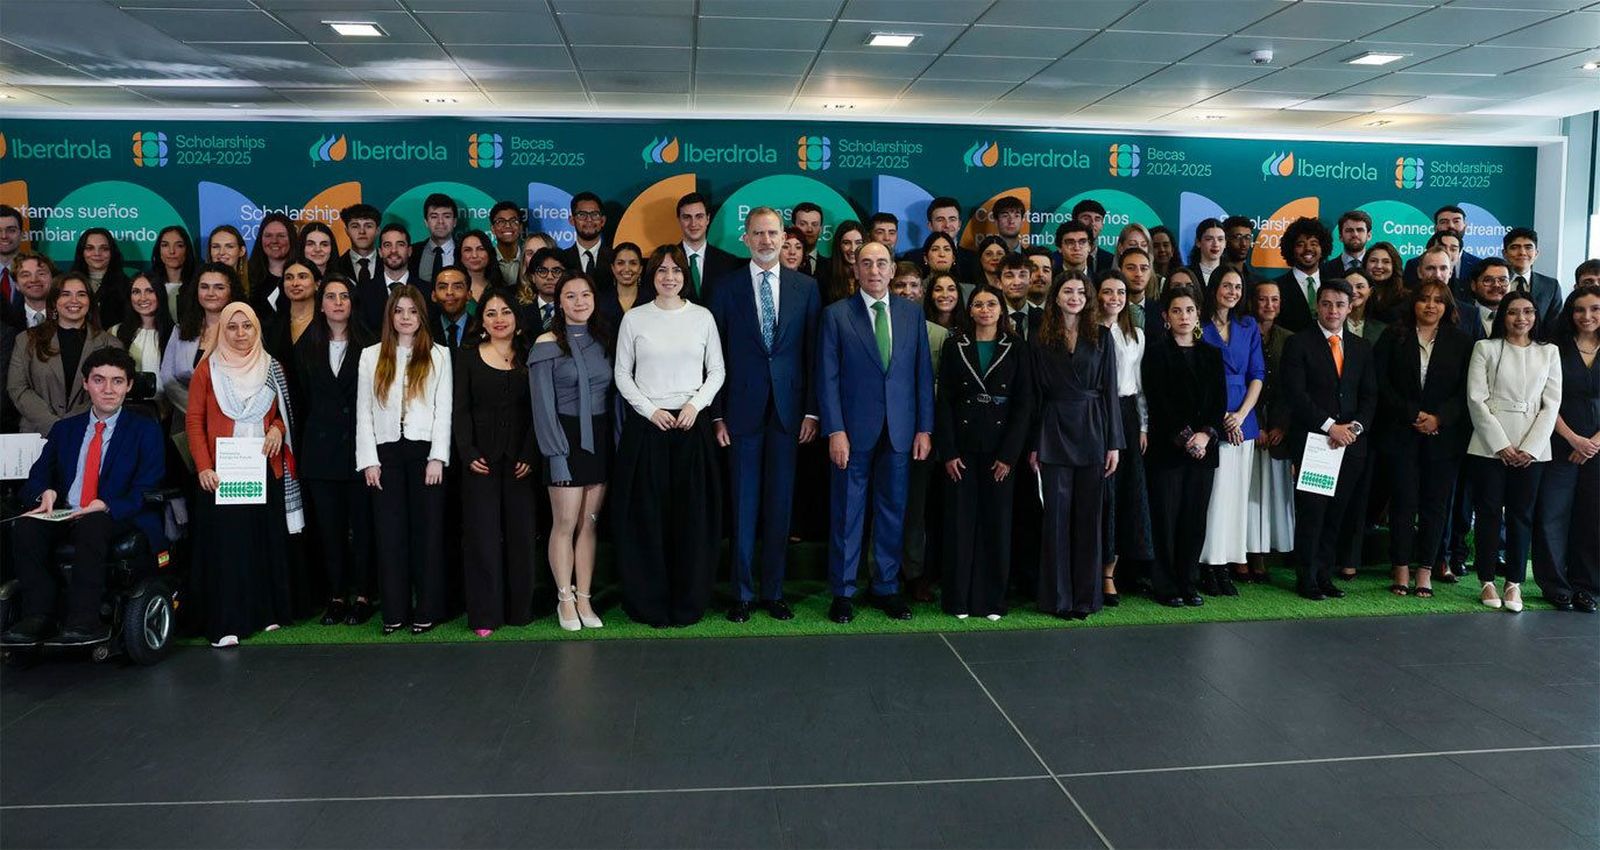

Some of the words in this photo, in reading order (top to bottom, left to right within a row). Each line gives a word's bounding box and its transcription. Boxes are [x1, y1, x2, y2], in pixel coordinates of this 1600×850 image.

[12, 138, 112, 160] Iberdrola
[175, 135, 266, 151] Scholarships
[352, 140, 448, 161] Iberdrola
[511, 136, 554, 150] Becas
[838, 138, 923, 155] Scholarships
[176, 151, 252, 166] 2024-2025
[511, 152, 585, 167] 2024-2025
[684, 142, 778, 164] Iberdrola
[1003, 147, 1091, 169] Iberdrola
[1147, 147, 1186, 161] Becas
[838, 154, 910, 169] 2024-2025
[1146, 162, 1212, 177] 2024-2025
[1297, 158, 1378, 181] Iberdrola
[1430, 160, 1503, 175] Scholarships
[1429, 175, 1491, 188] 2024-2025
[19, 203, 74, 219] tamos
[77, 203, 139, 219] sueños
[532, 205, 570, 219] drea
[975, 208, 1072, 224] Cotamos
[22, 226, 77, 242] ambiar
[1383, 220, 1435, 236] Connec
[1400, 242, 1425, 256] cha
[1477, 243, 1504, 256] wor
